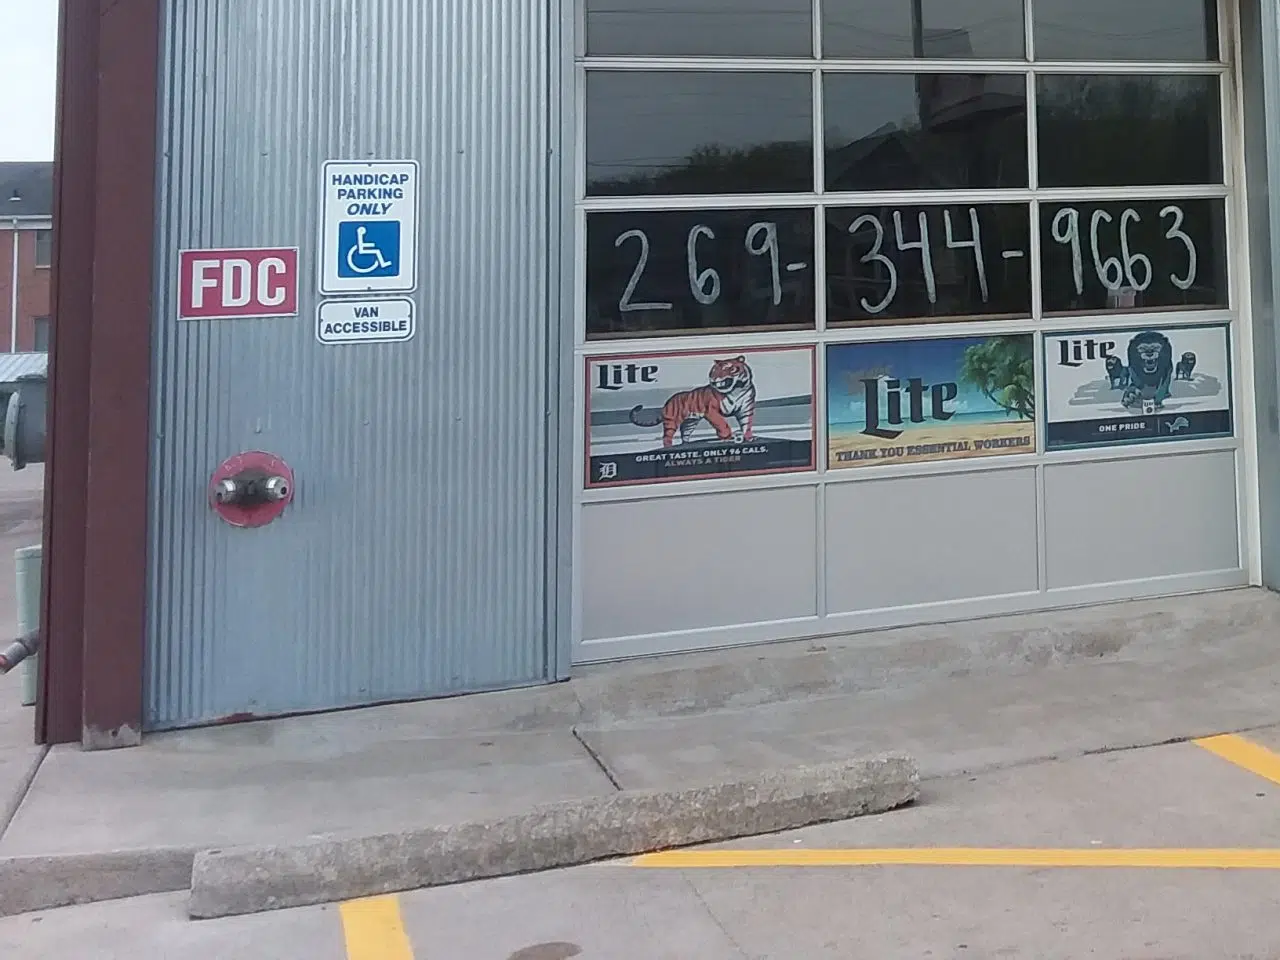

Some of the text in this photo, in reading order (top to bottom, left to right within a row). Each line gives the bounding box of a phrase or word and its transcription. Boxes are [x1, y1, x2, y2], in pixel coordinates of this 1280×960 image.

[331, 173, 410, 186] HANDICAP
[337, 187, 404, 200] PARKING
[346, 202, 393, 216] ONLY
[190, 257, 287, 309] FDC
[353, 306, 379, 318] VAN
[324, 320, 407, 334] ACCESSIBLE
[1057, 339, 1116, 368] Lite
[595, 363, 659, 390] Lite
[859, 376, 958, 439] Lite
[1098, 422, 1146, 432] ONE PRIDE
[635, 453, 667, 463] GREAT
[703, 448, 727, 457] ONLY
[729, 447, 741, 456] 96
[835, 435, 1031, 463] THANK YOU ESSENTIAL WORKERS
[664, 455, 741, 467] ALWAYS A TIGER
